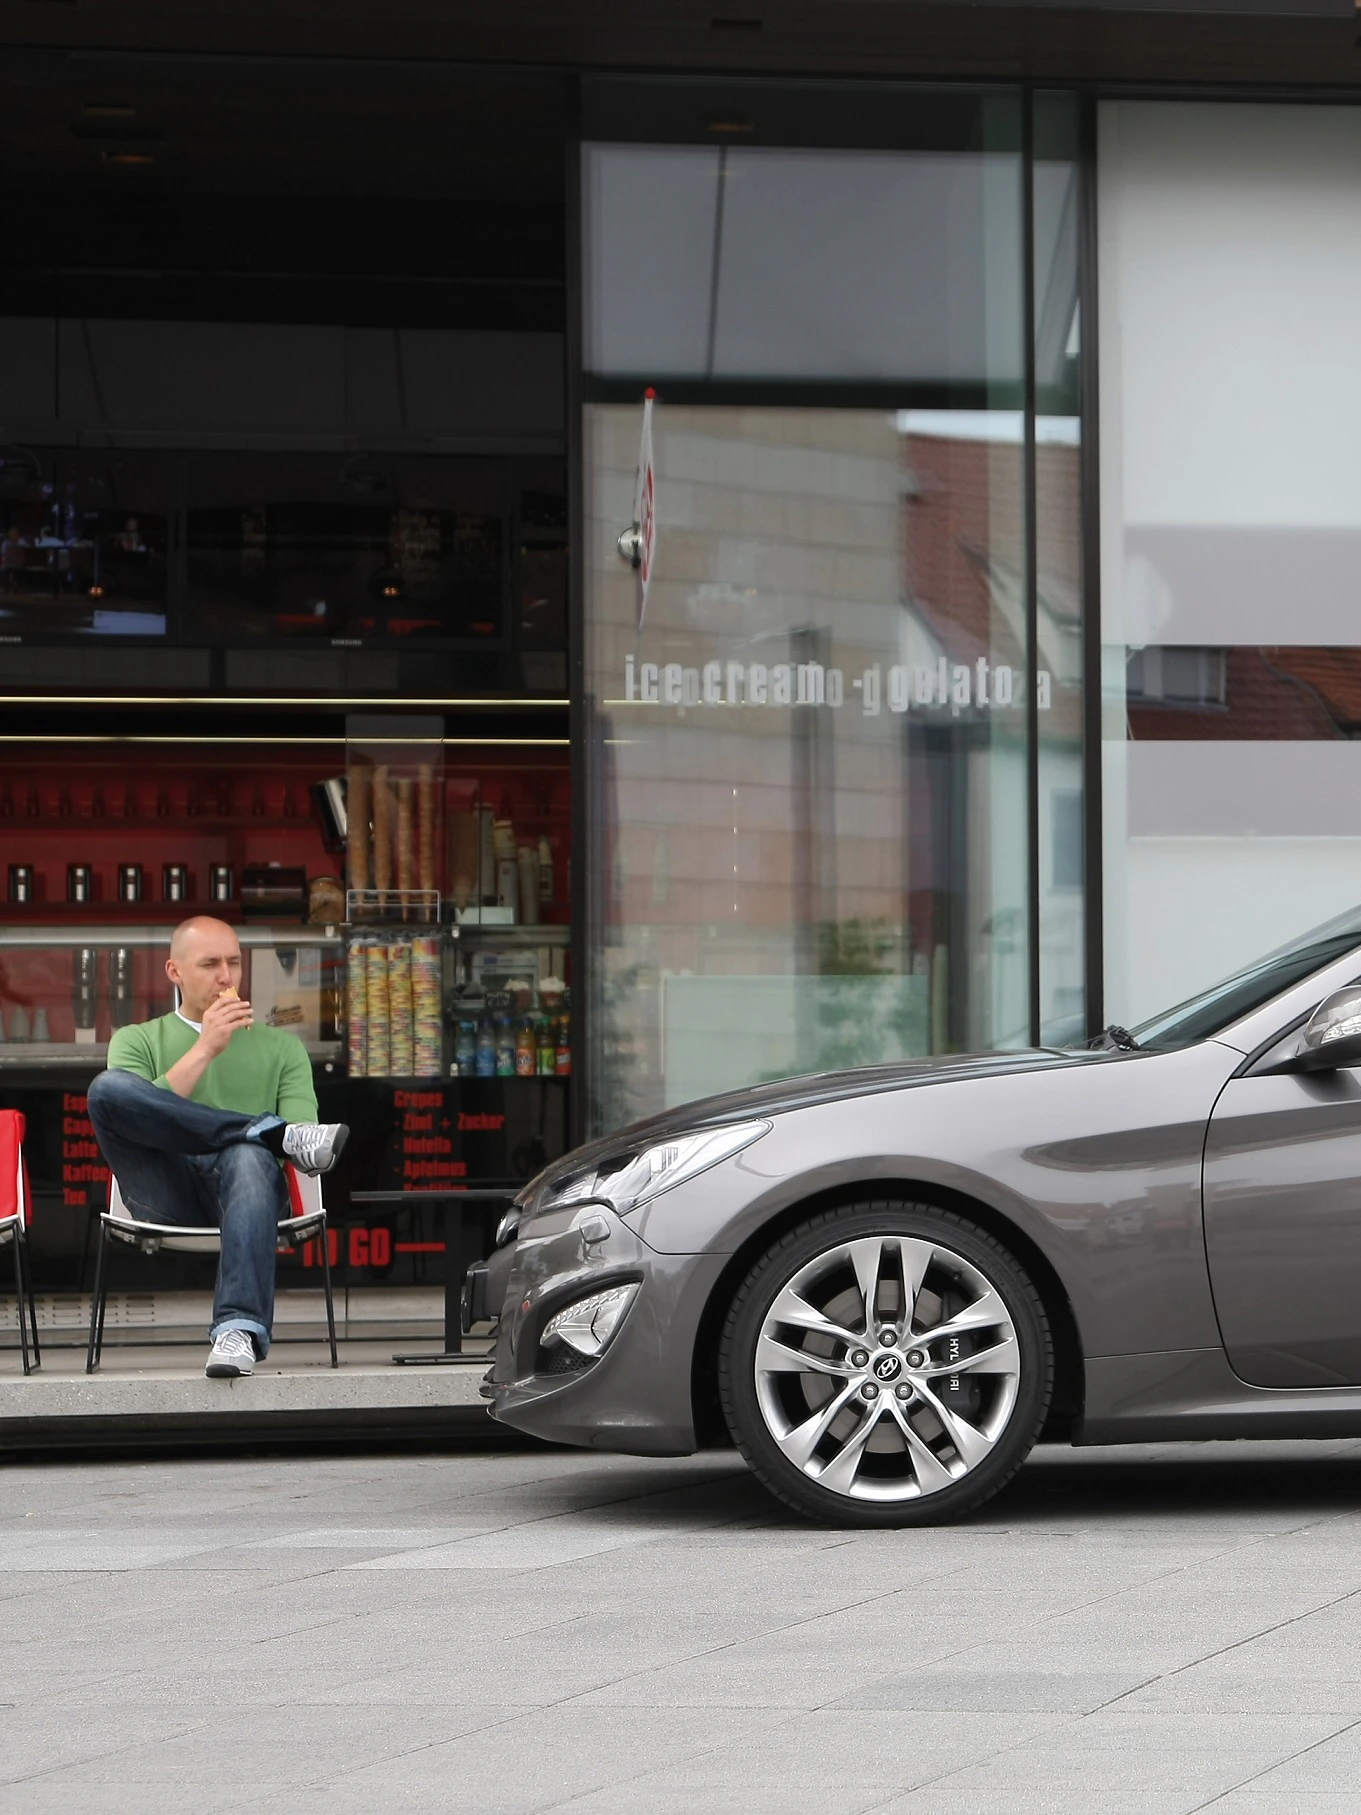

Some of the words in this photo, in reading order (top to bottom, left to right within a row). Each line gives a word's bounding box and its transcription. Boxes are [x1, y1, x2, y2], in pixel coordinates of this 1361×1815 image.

[625, 654, 682, 703] ice
[702, 662, 835, 703] cream
[889, 656, 1012, 712] gelato
[457, 1112, 505, 1131] Zucker
[63, 1141, 98, 1158] Latte
[403, 1136, 452, 1154] Nutella
[403, 1160, 467, 1180] Apfelmus
[349, 1228, 391, 1266] GO
